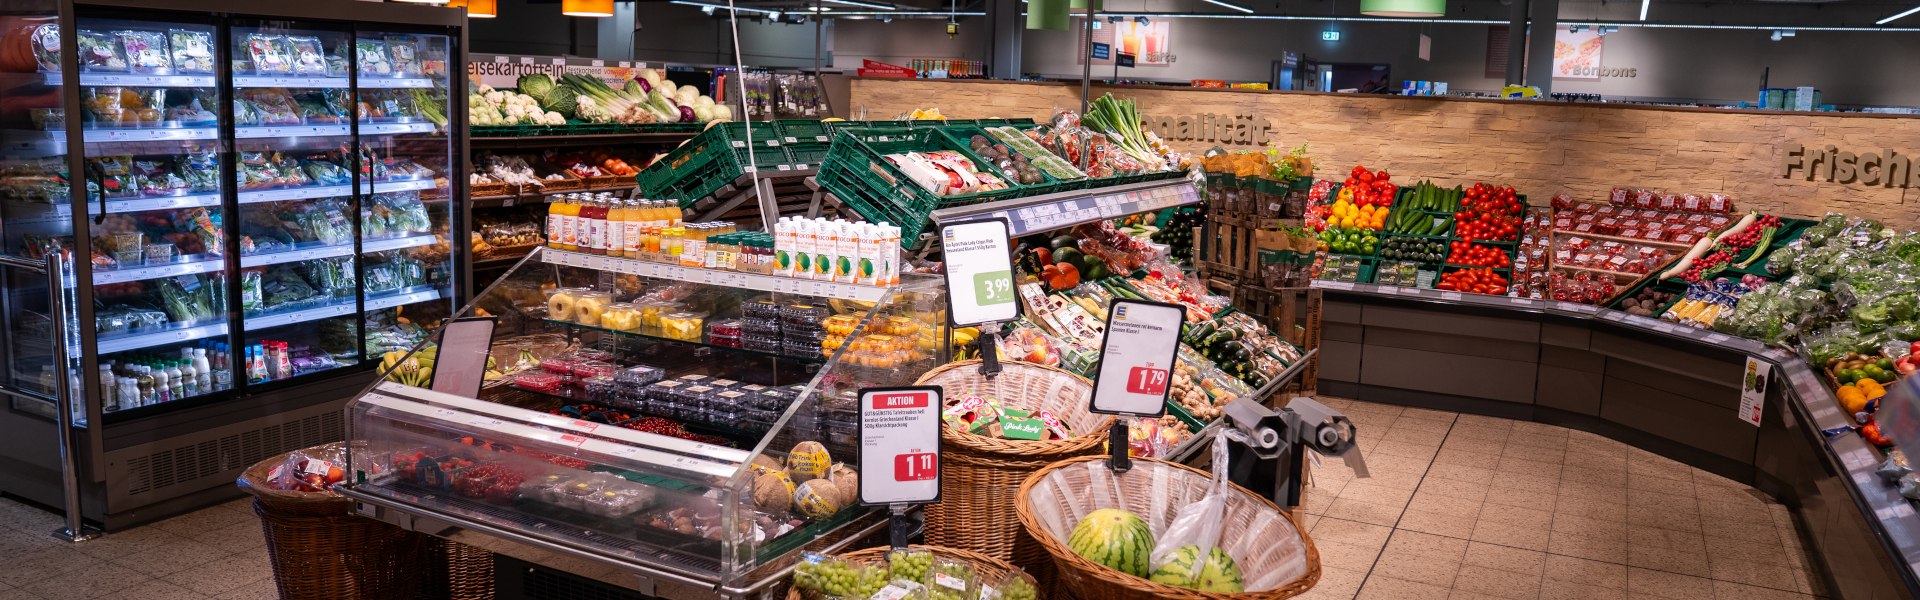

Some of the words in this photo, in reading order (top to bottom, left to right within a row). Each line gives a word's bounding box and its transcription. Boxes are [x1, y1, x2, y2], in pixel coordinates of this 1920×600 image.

[1145, 51, 1177, 62] Säfte
[1572, 64, 1638, 78] Bonbons
[887, 396, 914, 406] AKTION
[1004, 421, 1022, 431] Pink
[1022, 424, 1042, 434] Lady
